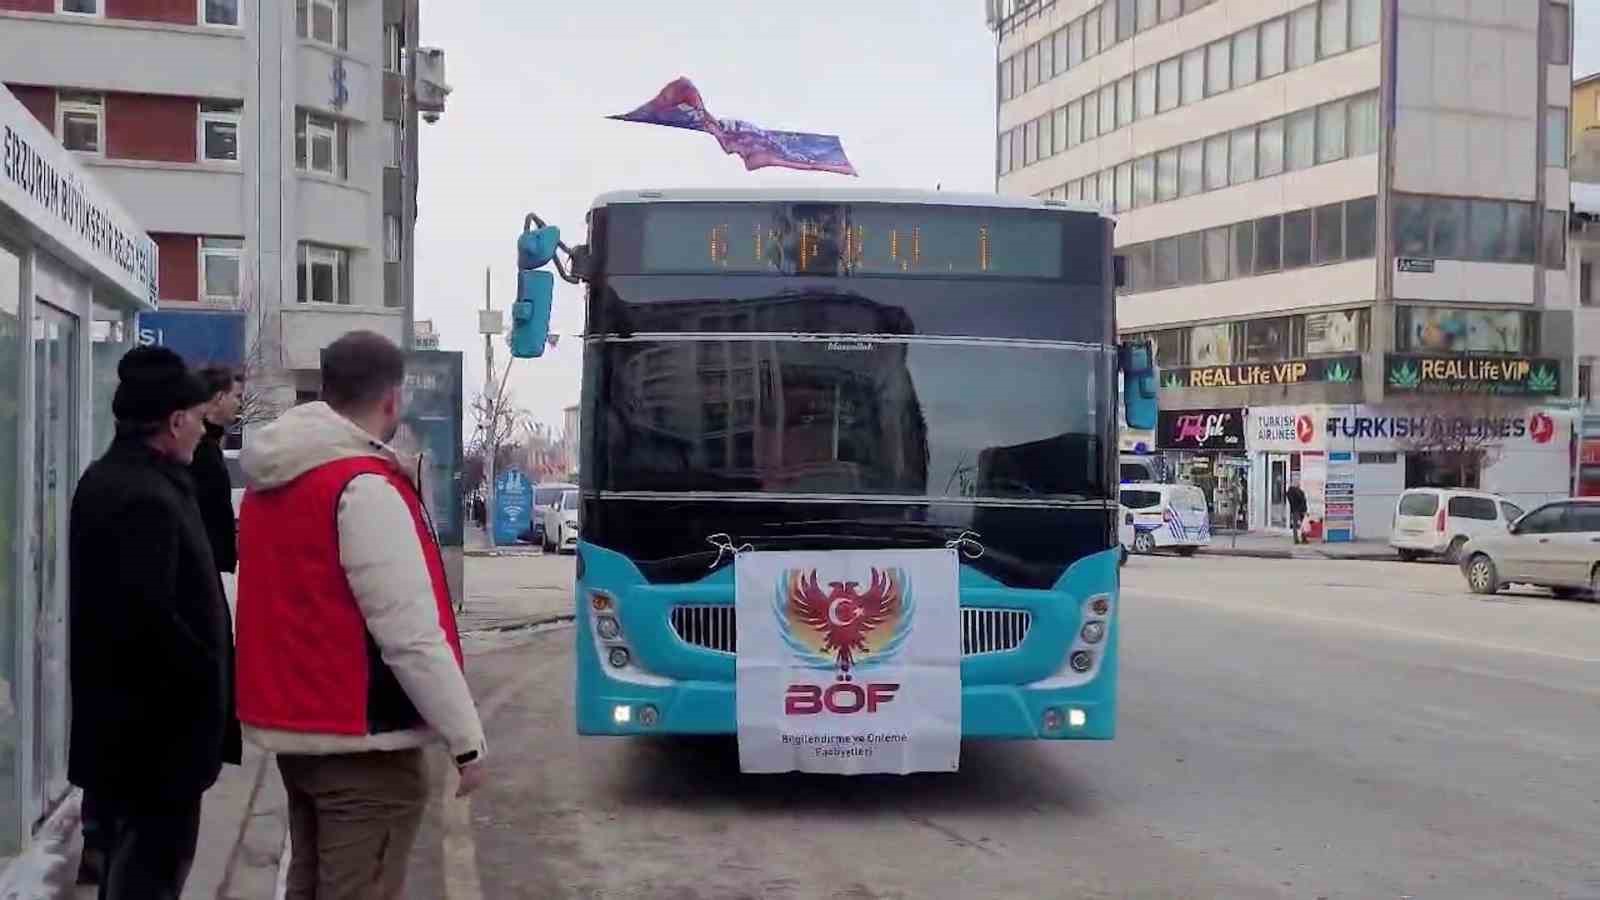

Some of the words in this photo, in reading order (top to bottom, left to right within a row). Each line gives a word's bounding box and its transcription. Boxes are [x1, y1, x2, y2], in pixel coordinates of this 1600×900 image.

[4, 125, 59, 216] ERZURUM
[1190, 368, 1236, 387] REAL
[1422, 359, 1467, 380] REAL
[1258, 415, 1296, 427] TURKISH
[1328, 416, 1425, 438] TURKISH
[1430, 416, 1525, 439] AIRLINES
[1258, 428, 1296, 441] AIRLINES
[784, 674, 900, 715] BÖF
